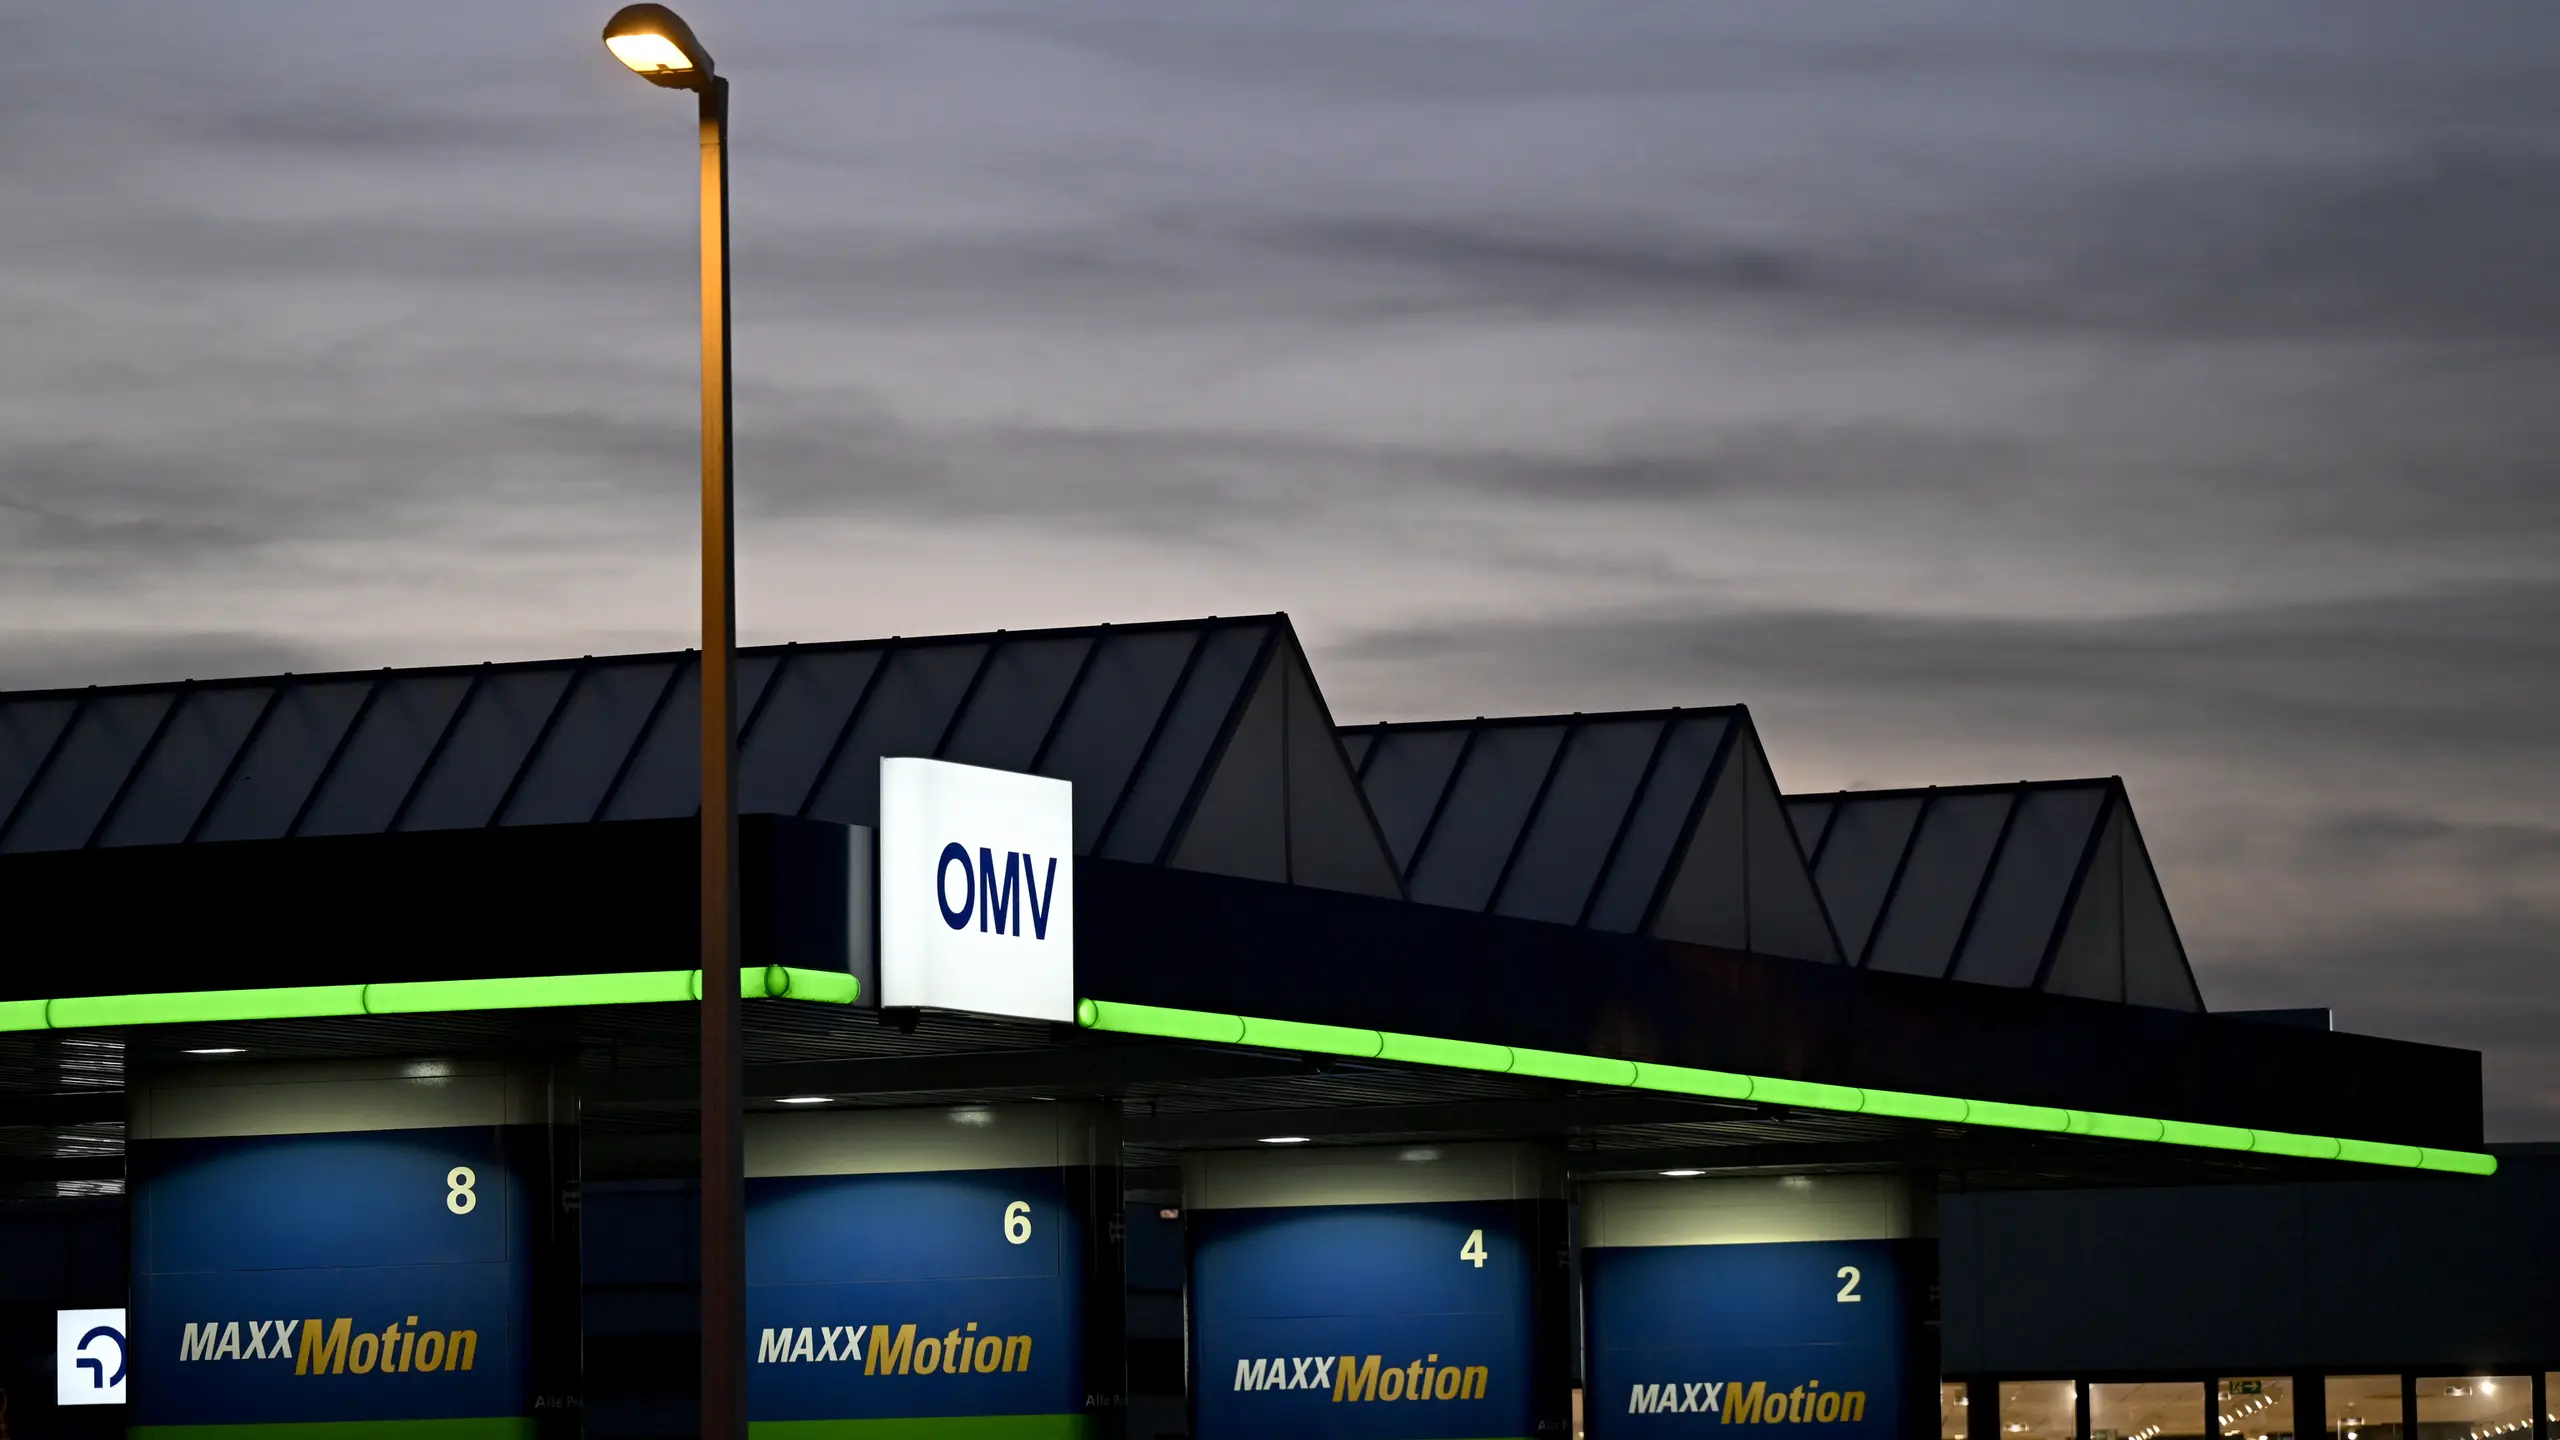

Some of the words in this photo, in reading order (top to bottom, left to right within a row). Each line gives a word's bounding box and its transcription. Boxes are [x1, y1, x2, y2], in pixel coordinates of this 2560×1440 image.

[937, 842, 1057, 940] OMV
[446, 1166, 477, 1215] 8
[1003, 1200, 1032, 1245] 6
[1459, 1229, 1489, 1269] 4
[1836, 1265, 1862, 1303] 2
[179, 1315, 478, 1376] MAXXMotion
[757, 1321, 1033, 1376] MAXXMotion
[1233, 1353, 1489, 1403] MAXXMotion
[1628, 1379, 1867, 1425] MAXXMotion
